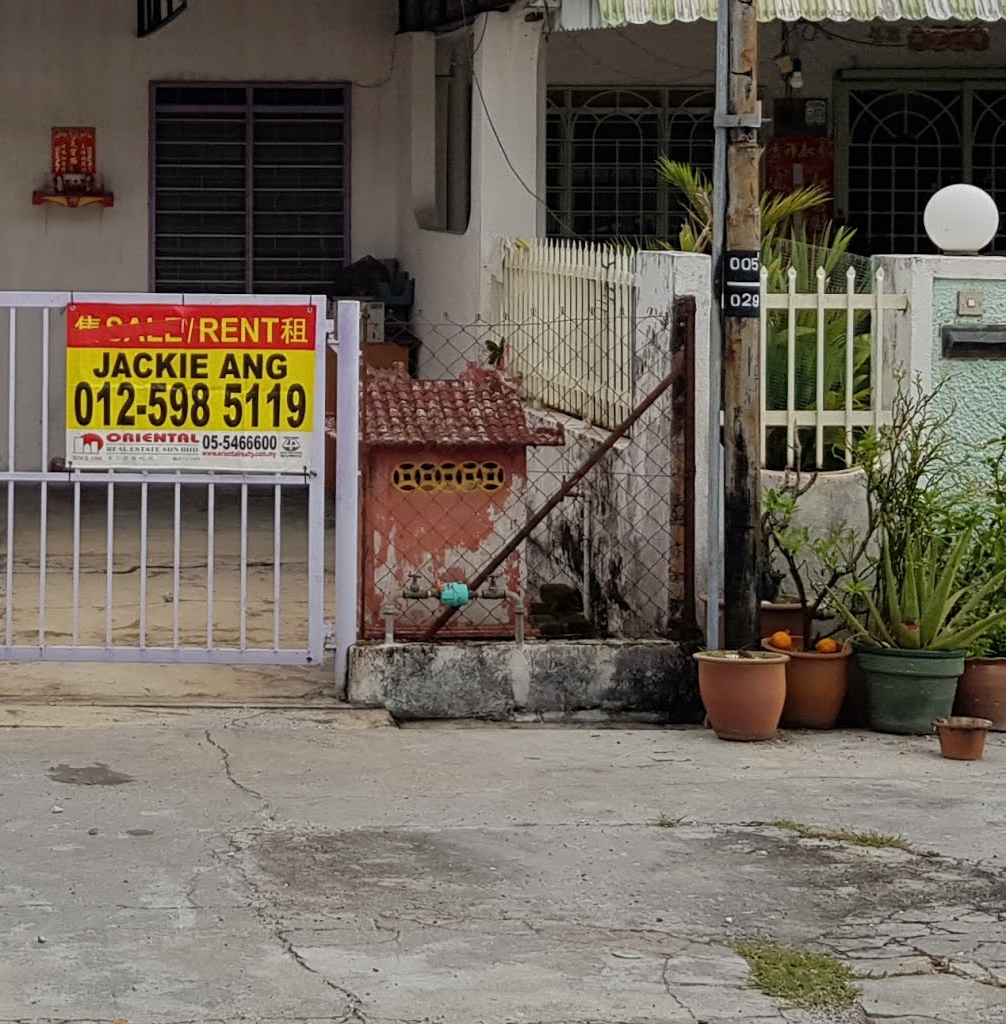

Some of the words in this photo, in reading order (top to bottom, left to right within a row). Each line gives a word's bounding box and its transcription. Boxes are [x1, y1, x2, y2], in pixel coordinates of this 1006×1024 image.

[729, 257, 759, 271] 005
[730, 293, 760, 307] 029
[281, 318, 308, 345] 租
[93, 352, 209, 379] JACKIE
[219, 353, 288, 379] ANG
[74, 382, 211, 427] 012-598
[223, 383, 307, 428] 5119
[106, 433, 200, 443] ORIENTAL
[202, 435, 277, 450] 05-5466600
